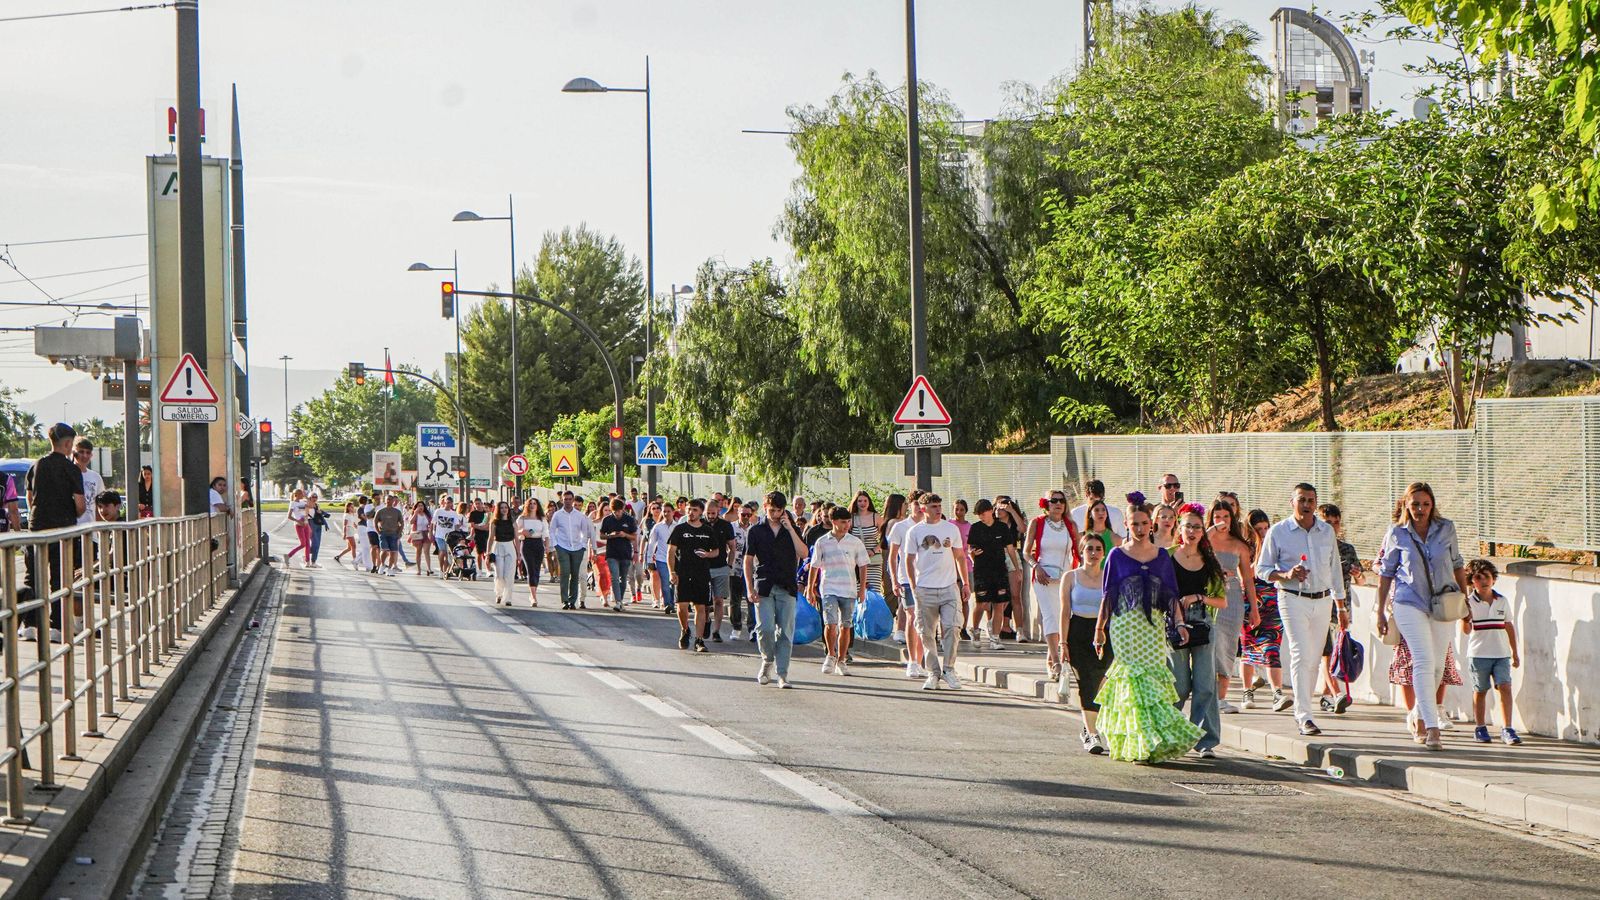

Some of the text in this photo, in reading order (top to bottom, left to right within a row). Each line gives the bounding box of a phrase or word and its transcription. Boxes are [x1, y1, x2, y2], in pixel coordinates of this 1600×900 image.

[177, 406, 203, 414] SALIDA
[911, 432, 935, 440] SALIDA
[906, 438, 942, 446] BOMBEROS
